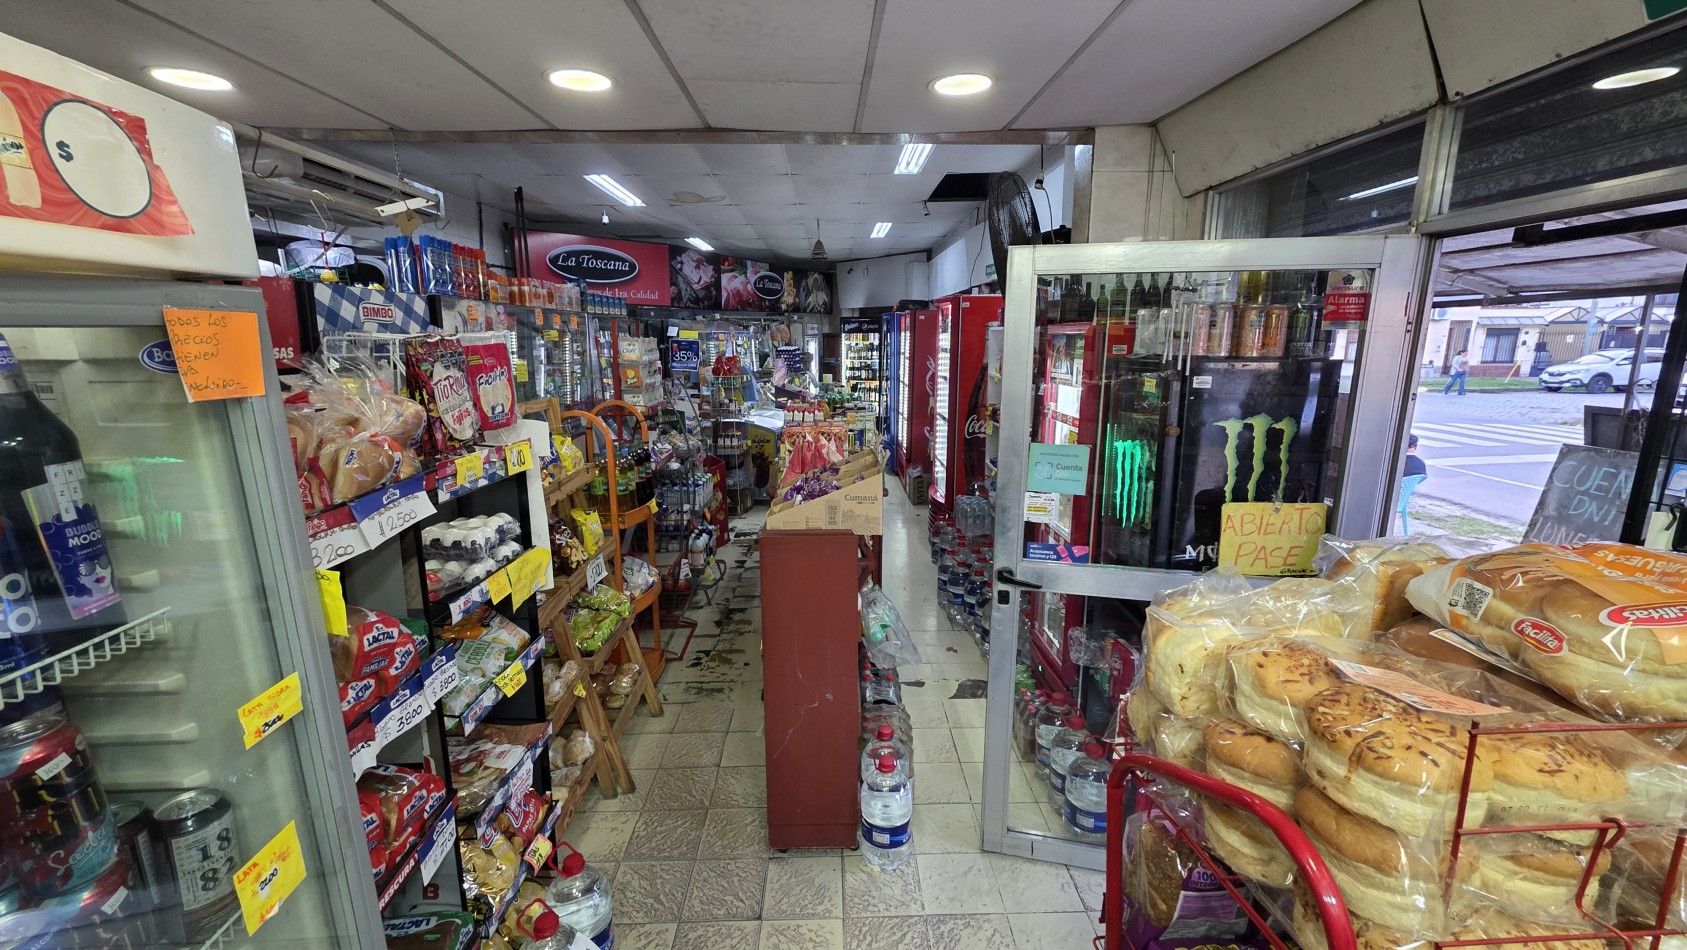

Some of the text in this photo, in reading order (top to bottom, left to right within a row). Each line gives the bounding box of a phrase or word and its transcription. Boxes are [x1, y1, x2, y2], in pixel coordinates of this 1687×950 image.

[55, 139, 73, 163] $
[557, 253, 630, 272] La Toscana
[630, 289, 659, 300] Calidad
[1327, 295, 1365, 304] Alarma
[208, 313, 227, 328] LOS
[362, 305, 394, 320] BIMBO
[152, 348, 174, 362] Ba
[273, 347, 295, 360] SAS
[673, 350, 698, 362] 35%
[1055, 463, 1083, 472] Cuenta
[1552, 460, 1636, 501] CUEN
[844, 494, 878, 502] Cumaná
[1223, 506, 1323, 537] ABIERTO
[1233, 541, 1305, 570] PASE
[1621, 606, 1687, 621] cilitas
[365, 630, 396, 647] LACTAL
[362, 658, 389, 674] FAMILIAR
[396, 704, 424, 734] 3800
[405, 793, 427, 816] LACTAL
[425, 793, 446, 816] LACTAL
[363, 817, 378, 831] TAL
[236, 861, 260, 884] LATA
[379, 860, 416, 911] RESCURA
